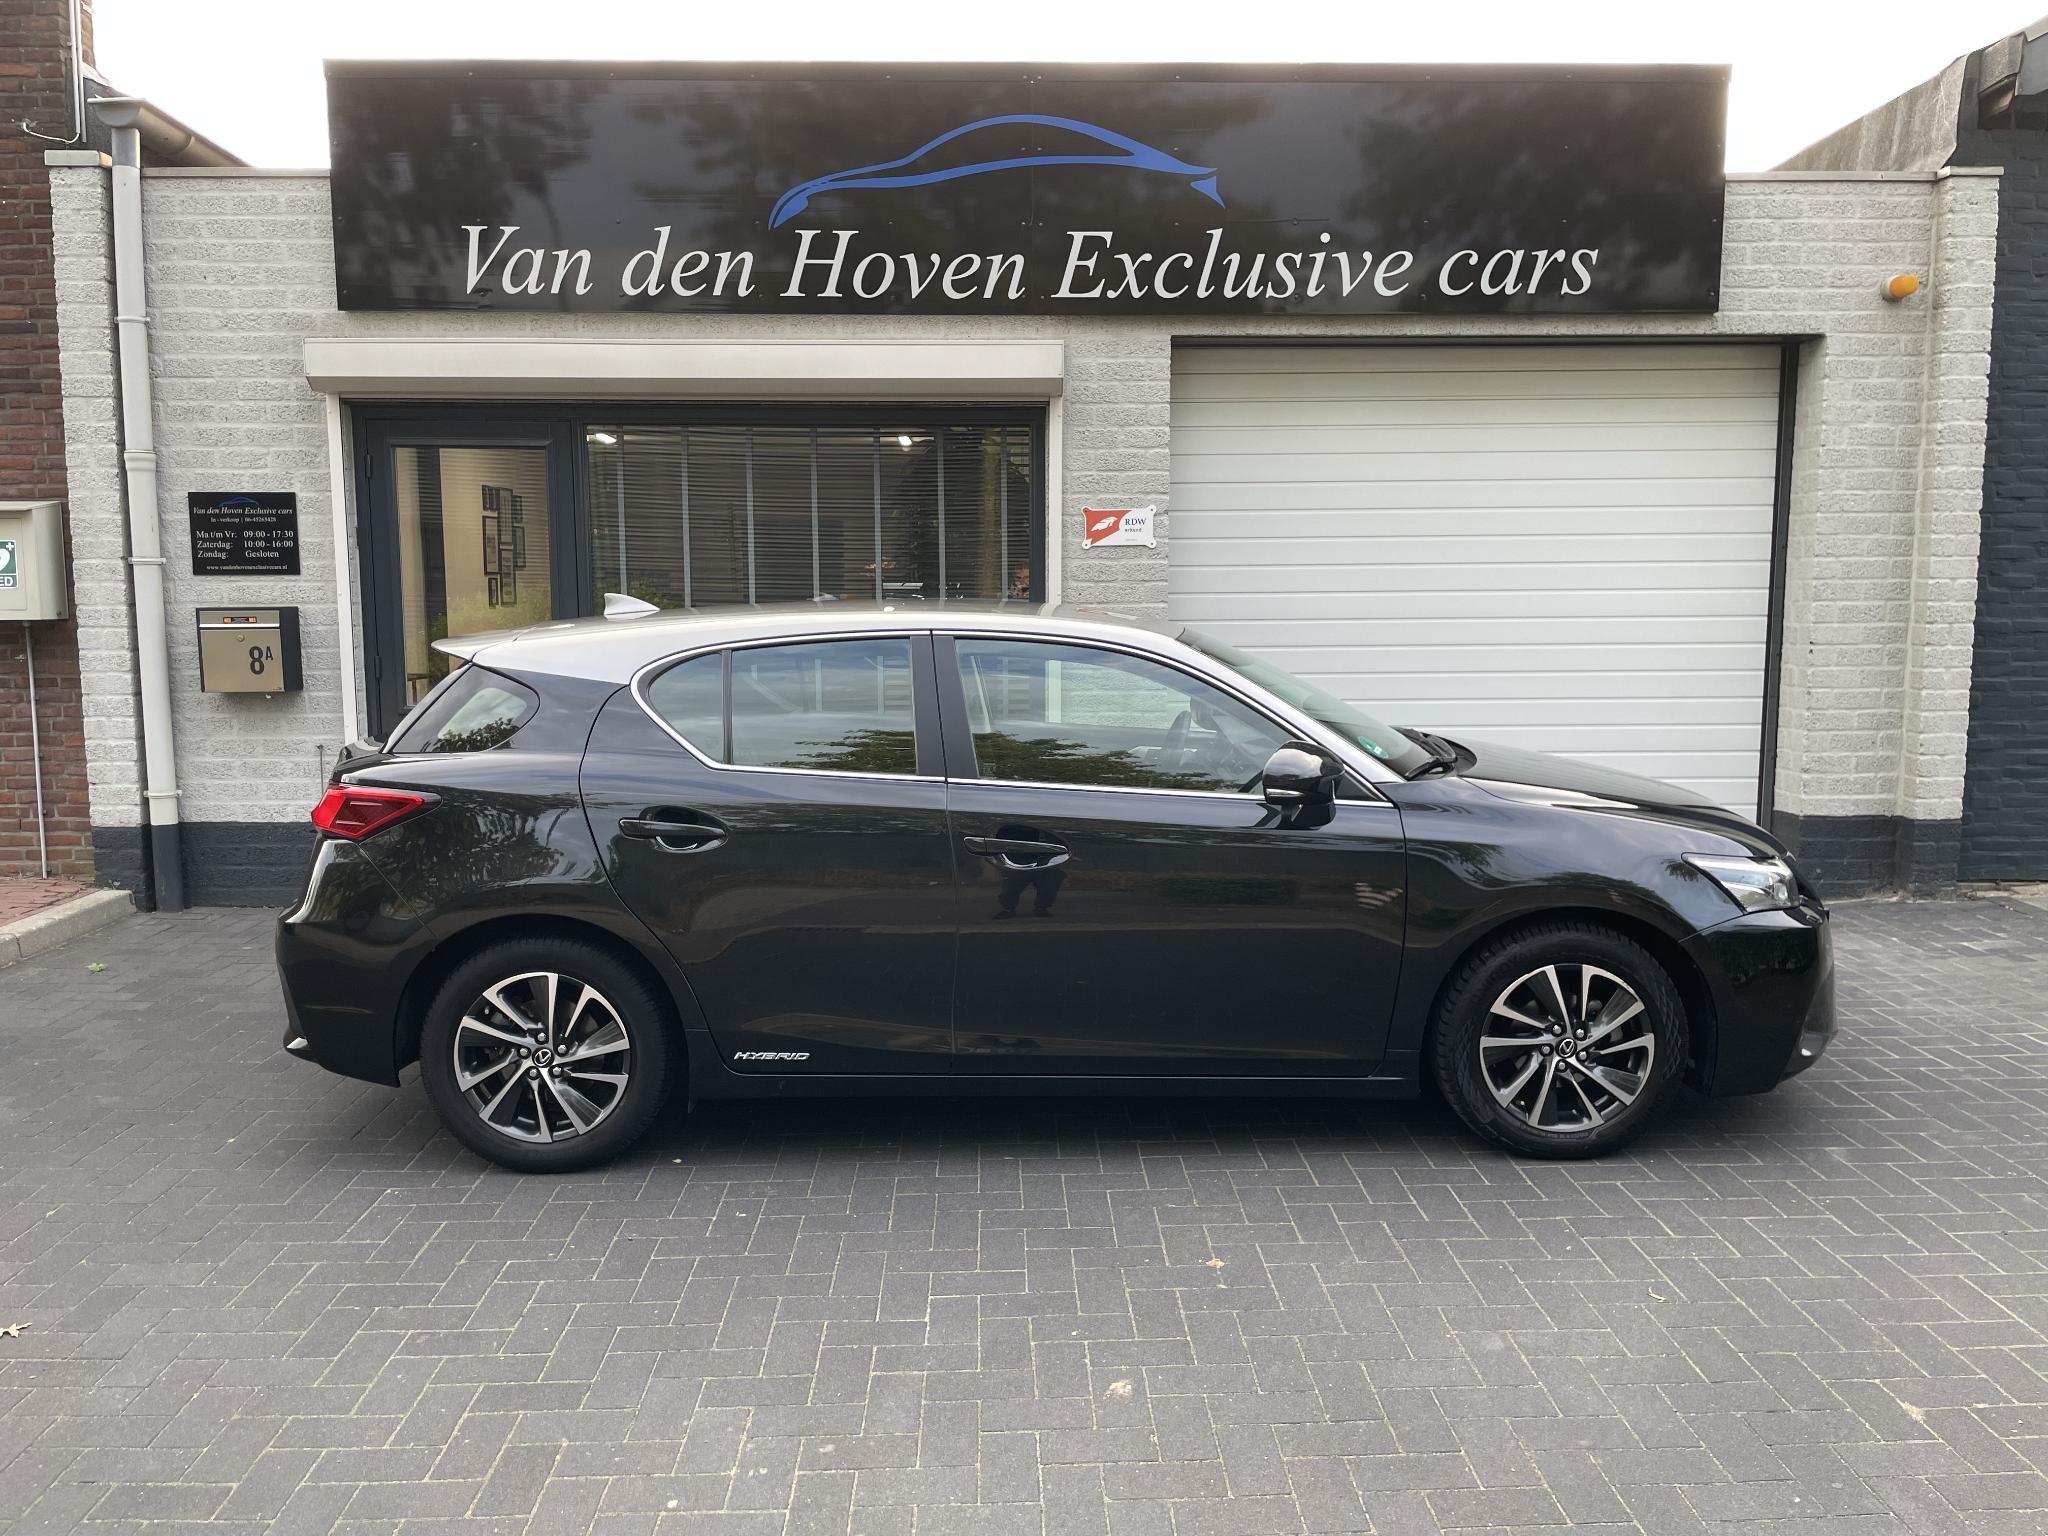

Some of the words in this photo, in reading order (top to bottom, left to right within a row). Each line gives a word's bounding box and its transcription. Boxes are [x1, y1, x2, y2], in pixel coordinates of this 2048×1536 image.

[461, 225, 593, 296] Van
[621, 225, 756, 297] den
[780, 229, 1026, 299] Hoven
[1051, 227, 1414, 299] Exclusive
[1438, 247, 1599, 296] cars
[1125, 517, 1147, 526] RDW
[243, 530, 265, 538] 09:00
[272, 530, 293, 538] 17:30
[197, 540, 233, 550] Zaterdag:
[244, 540, 265, 548] 10:00
[272, 540, 293, 548] 16:00
[197, 550, 229, 559] Zondag:
[245, 550, 279, 558] Gesloten
[733, 1051, 811, 1061] HYBRID
